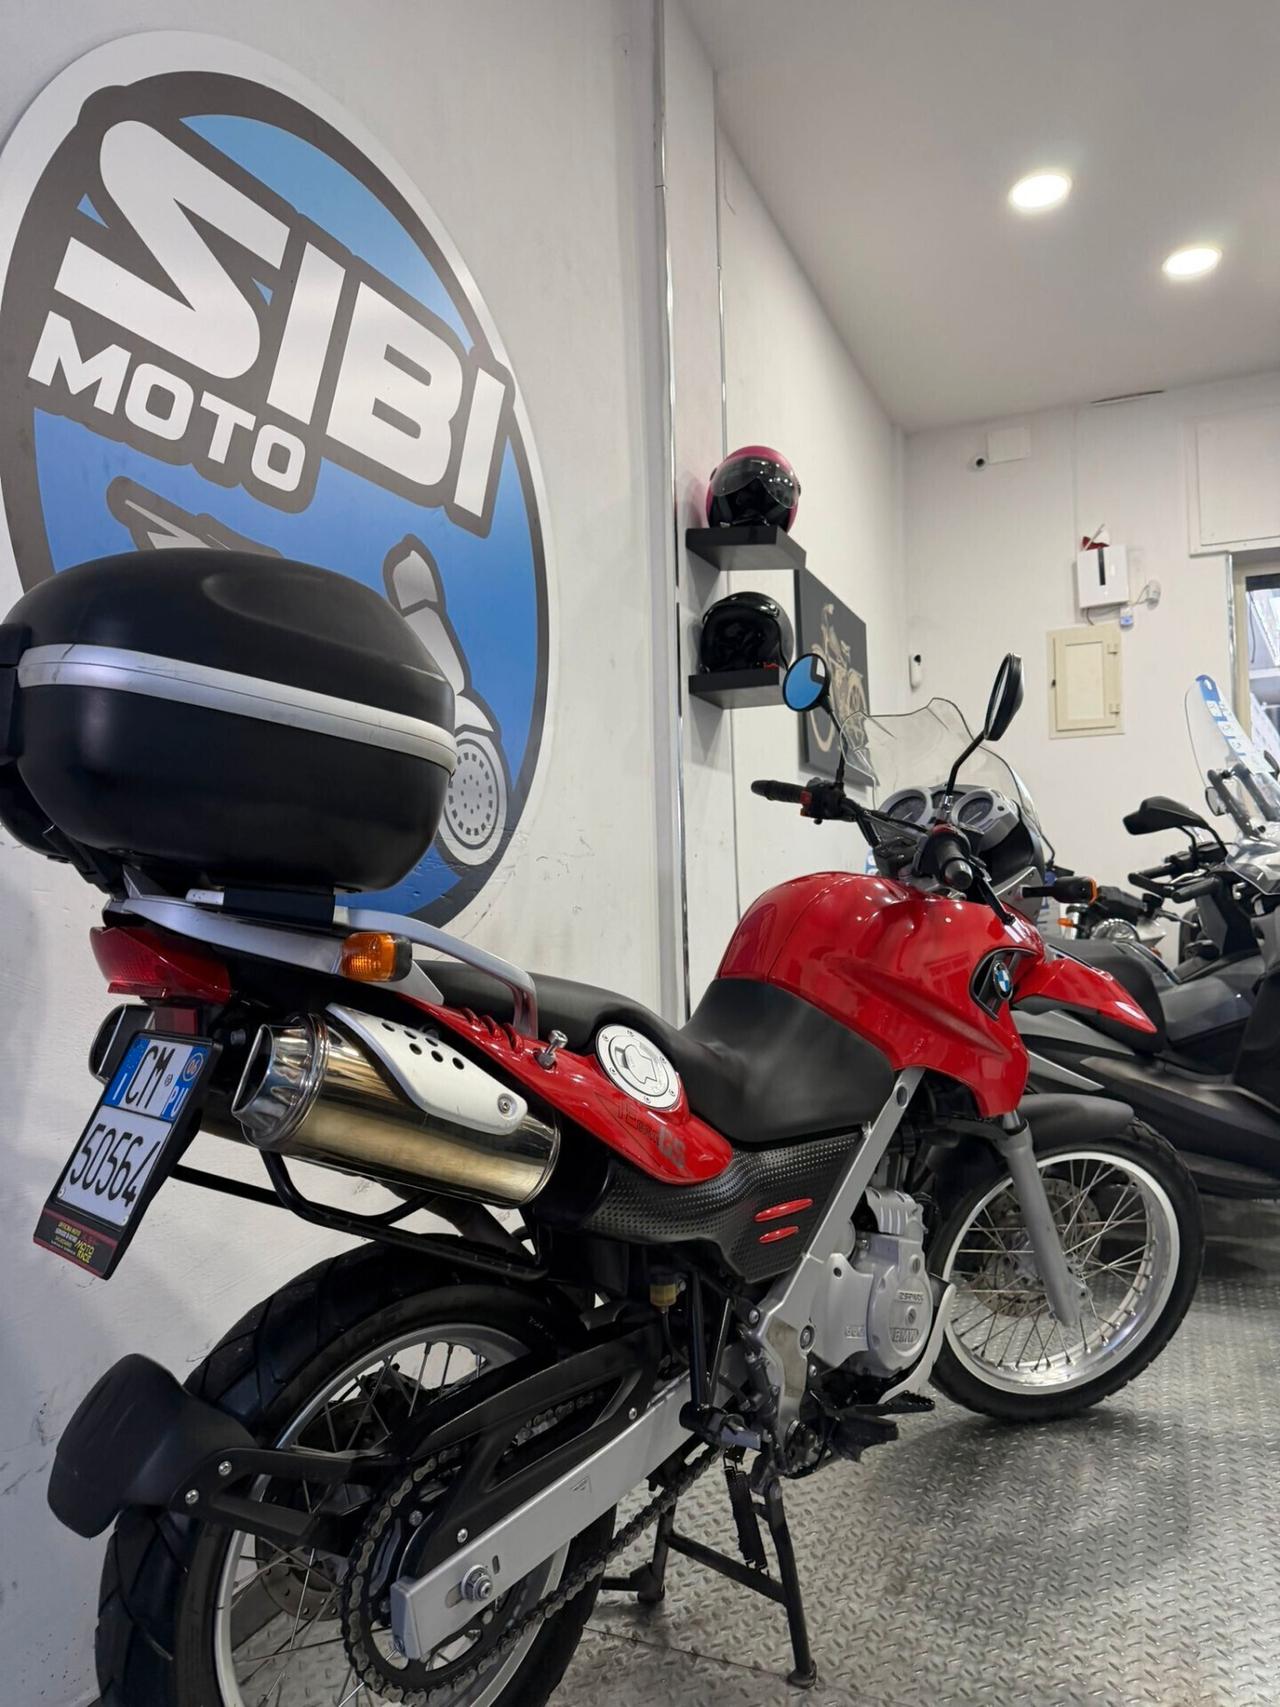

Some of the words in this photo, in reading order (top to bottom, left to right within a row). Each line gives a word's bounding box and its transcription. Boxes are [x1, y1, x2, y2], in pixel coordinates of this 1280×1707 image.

[53, 119, 506, 518] SIBI
[27, 309, 306, 493] MOTO
[125, 1045, 175, 1109] CM
[161, 1085, 189, 1118] PU
[70, 1123, 160, 1207] 50564
